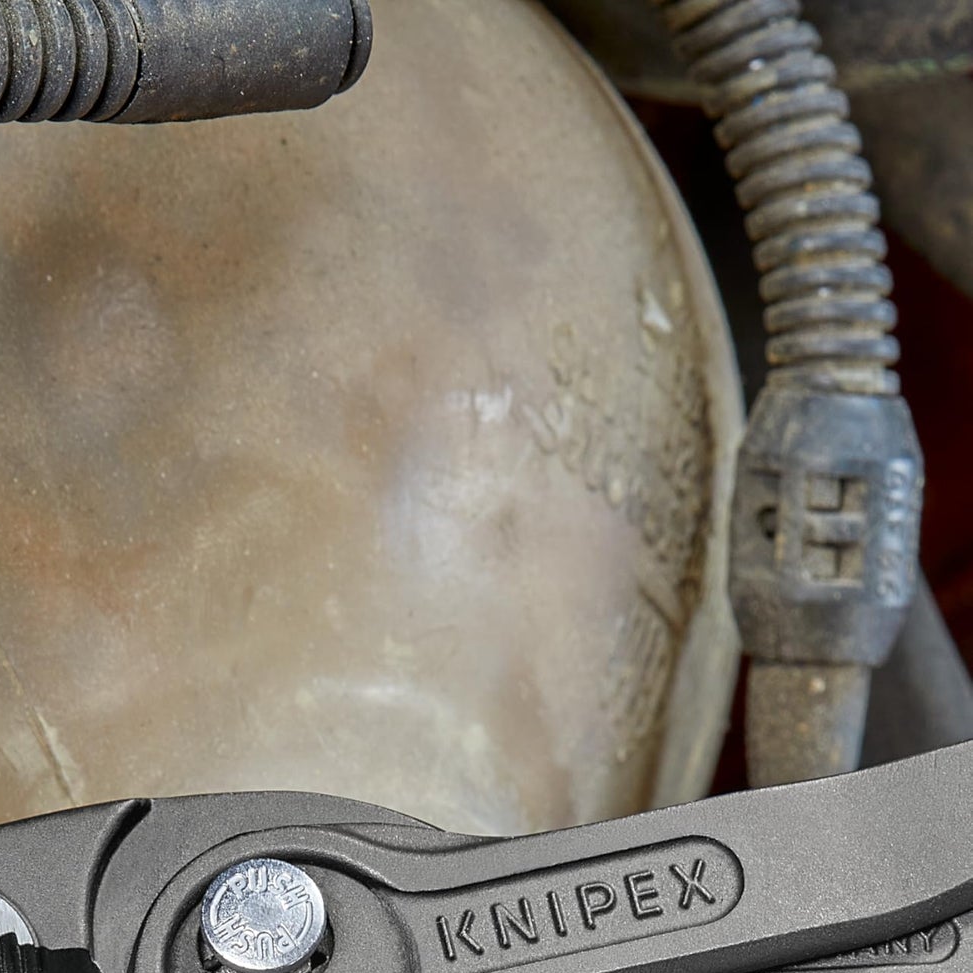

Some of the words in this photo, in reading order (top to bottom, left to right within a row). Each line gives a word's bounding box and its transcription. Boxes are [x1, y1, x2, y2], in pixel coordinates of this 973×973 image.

[226, 865, 311, 911] PUSH
[435, 858, 717, 962] KNIPEX
[212, 912, 299, 960] PUSH
